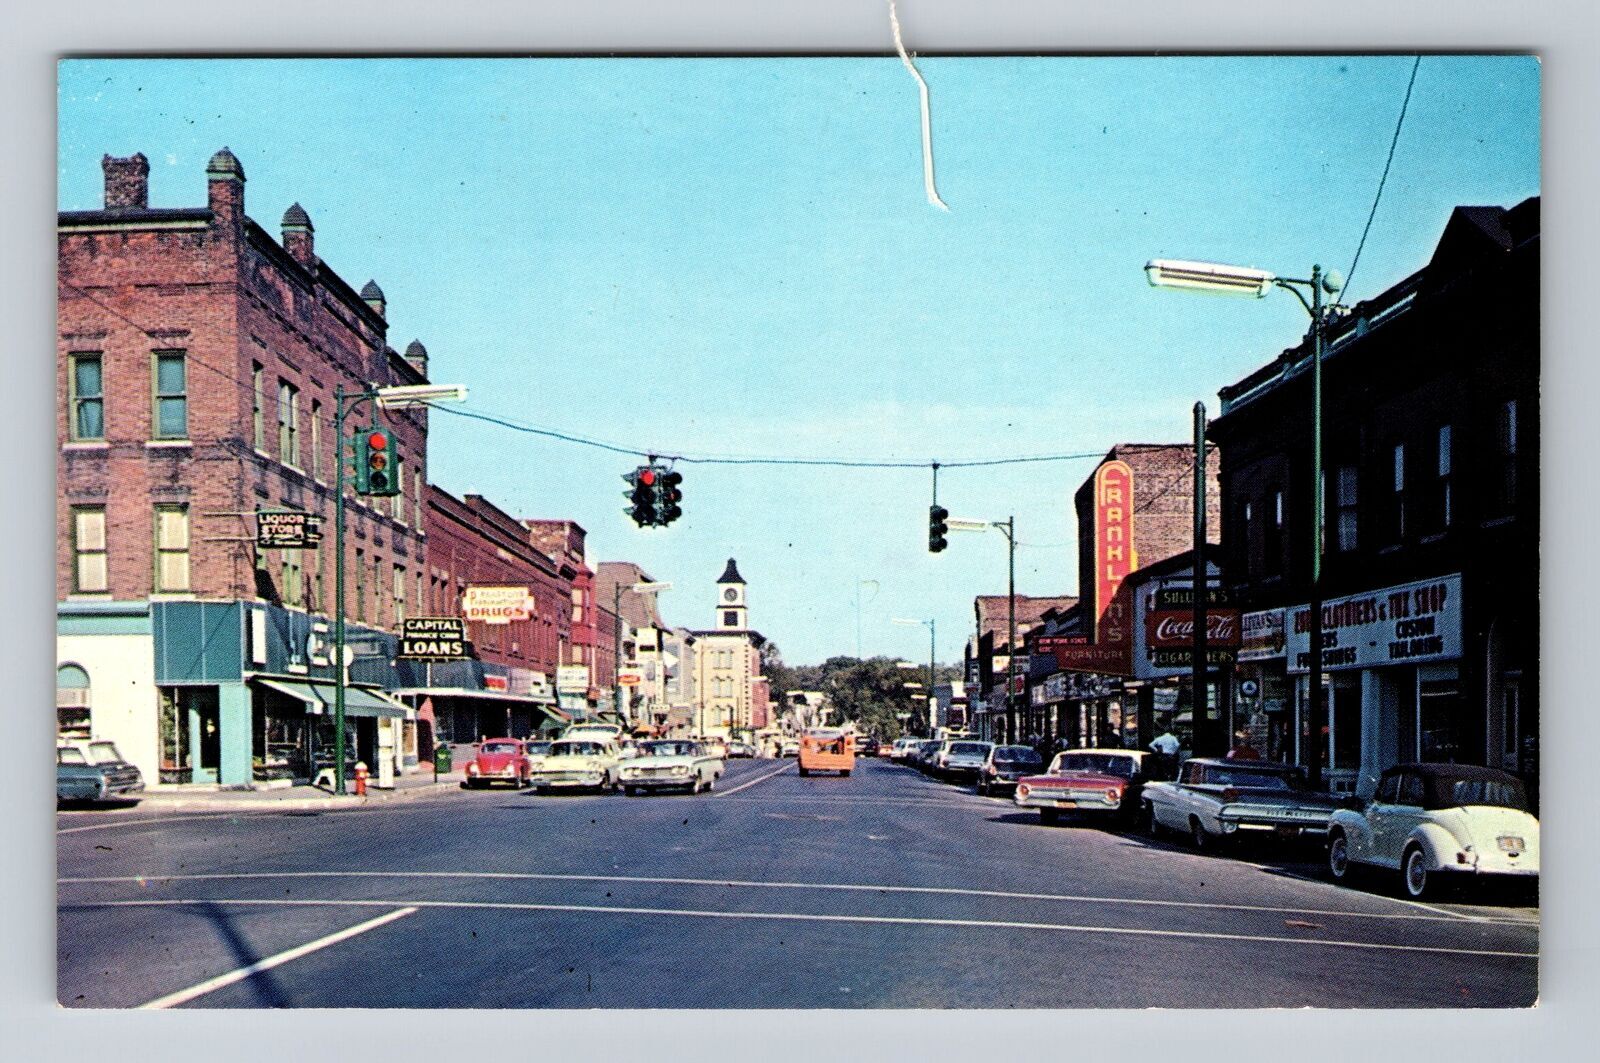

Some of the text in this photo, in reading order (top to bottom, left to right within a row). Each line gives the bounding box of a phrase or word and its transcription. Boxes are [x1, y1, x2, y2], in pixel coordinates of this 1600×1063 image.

[259, 514, 306, 527] LIQUOR
[260, 525, 306, 539] STORE
[1388, 591, 1410, 620] TUX
[1415, 583, 1447, 617] SHOP
[471, 607, 525, 617] DRUGS
[406, 620, 462, 631] CAPITAL
[1396, 616, 1435, 640] CUSTOM
[404, 641, 464, 655] LOANS
[1388, 635, 1444, 660] TAILORING
[1065, 650, 1123, 661] FURNITURE
